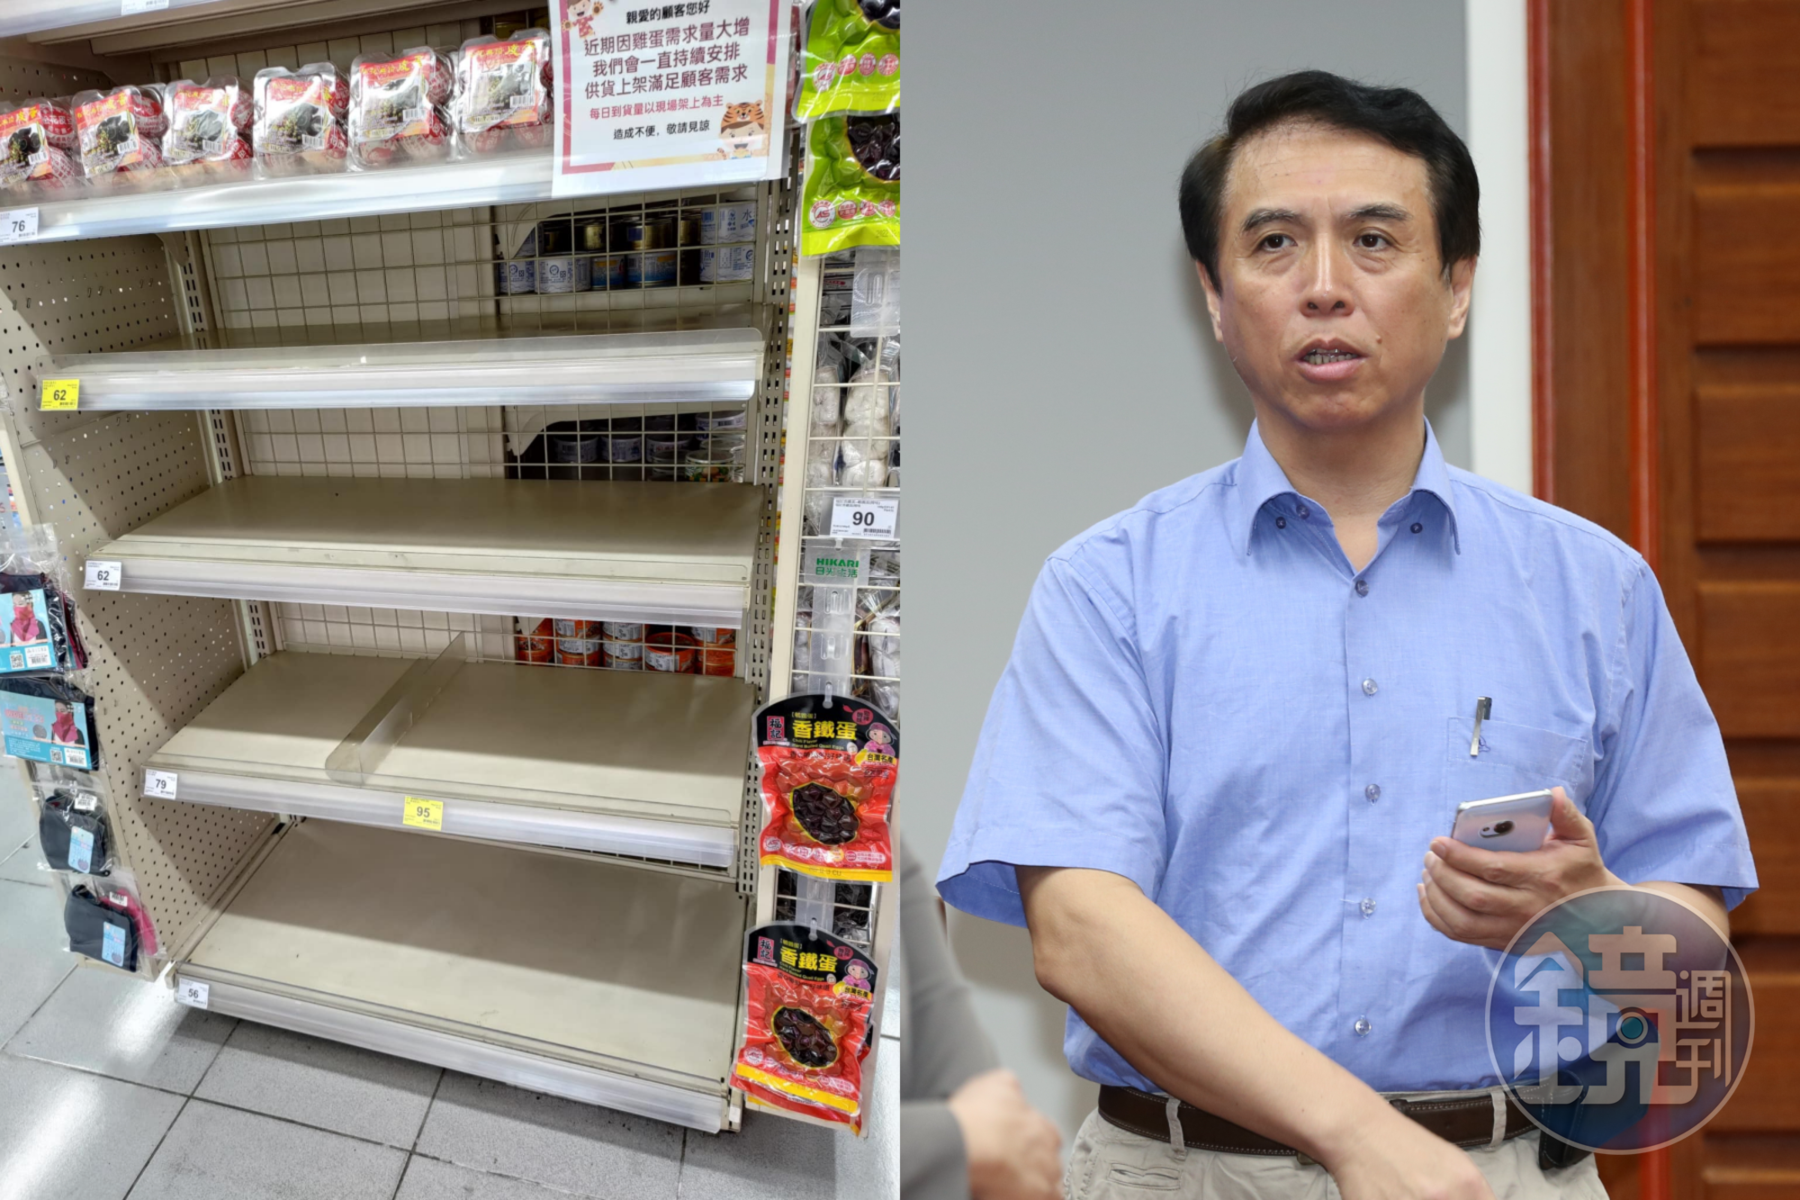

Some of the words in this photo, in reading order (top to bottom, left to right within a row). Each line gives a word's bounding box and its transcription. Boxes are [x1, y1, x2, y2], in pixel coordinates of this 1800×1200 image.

[626, 0, 710, 24] 親愛的顧客您好
[584, 17, 750, 56] 近期因雞蛋需求量大增
[592, 41, 740, 77] 我們會一直持續安排
[585, 63, 748, 99] 供貨上架滿足顧客需求
[590, 94, 723, 120] 每日到貨量以現場架上為主
[12, 220, 25, 232] 76
[53, 389, 67, 401] 62
[852, 511, 875, 526] 90
[816, 557, 860, 568] HIKARI
[97, 570, 110, 581] 62
[769, 718, 782, 739] 福記
[793, 720, 858, 740] 香鐵蛋
[155, 778, 167, 789] 79
[416, 806, 430, 818] 95
[781, 946, 838, 972] 香鐵蛋
[188, 988, 199, 999] 56
